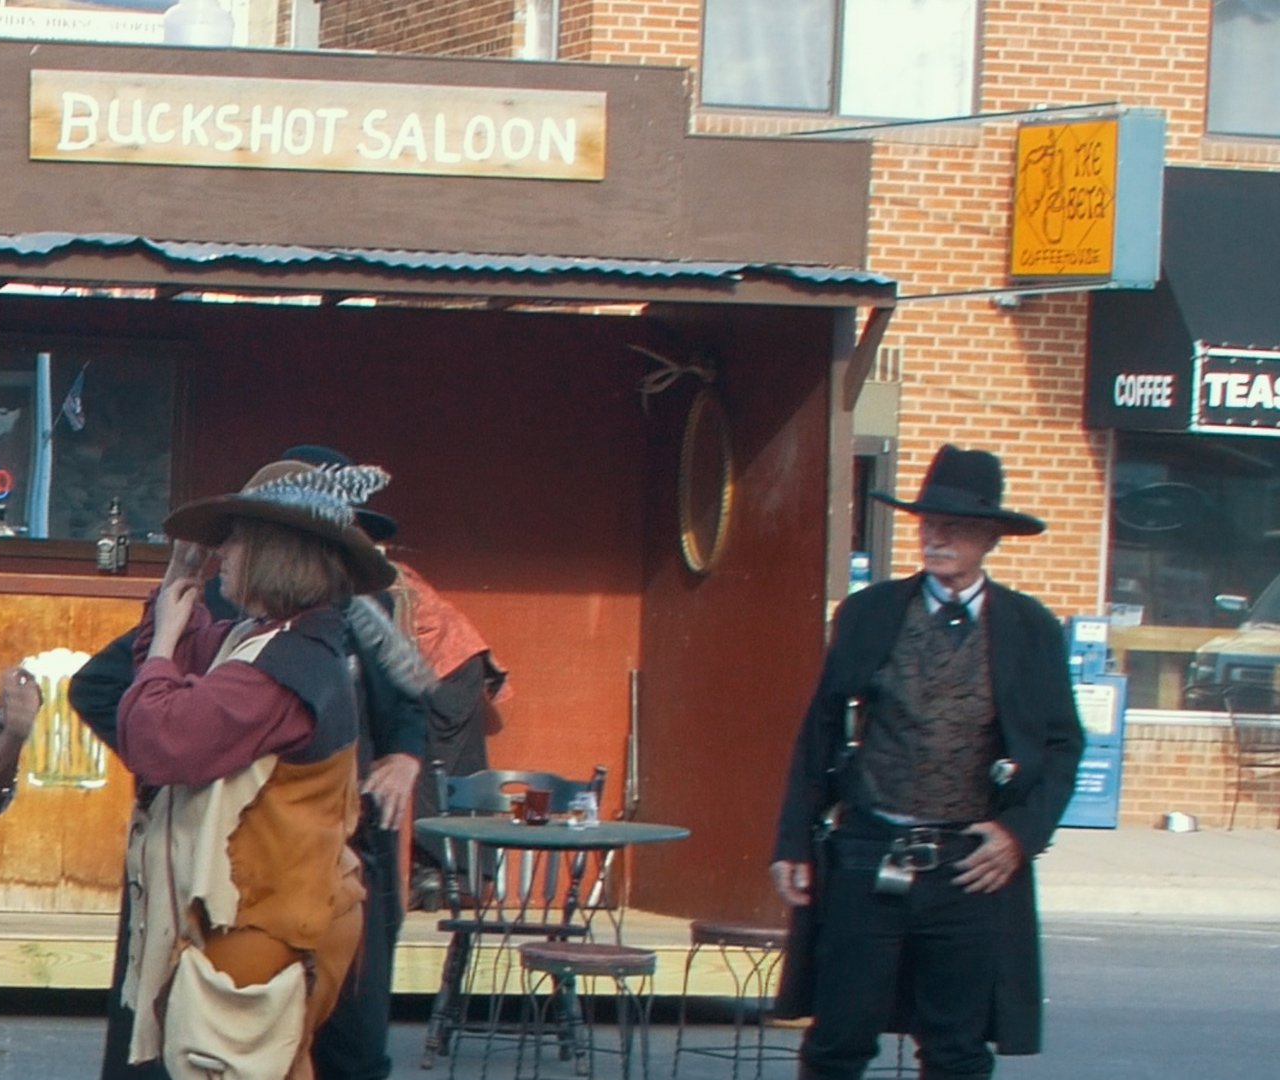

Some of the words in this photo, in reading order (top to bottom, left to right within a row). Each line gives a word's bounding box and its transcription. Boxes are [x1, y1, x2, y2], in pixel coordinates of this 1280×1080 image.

[57, 91, 347, 154] BUCKSHOT
[356, 108, 577, 165] SALOON
[1113, 373, 1176, 408] COFFEE
[1203, 372, 1280, 409] TEA
